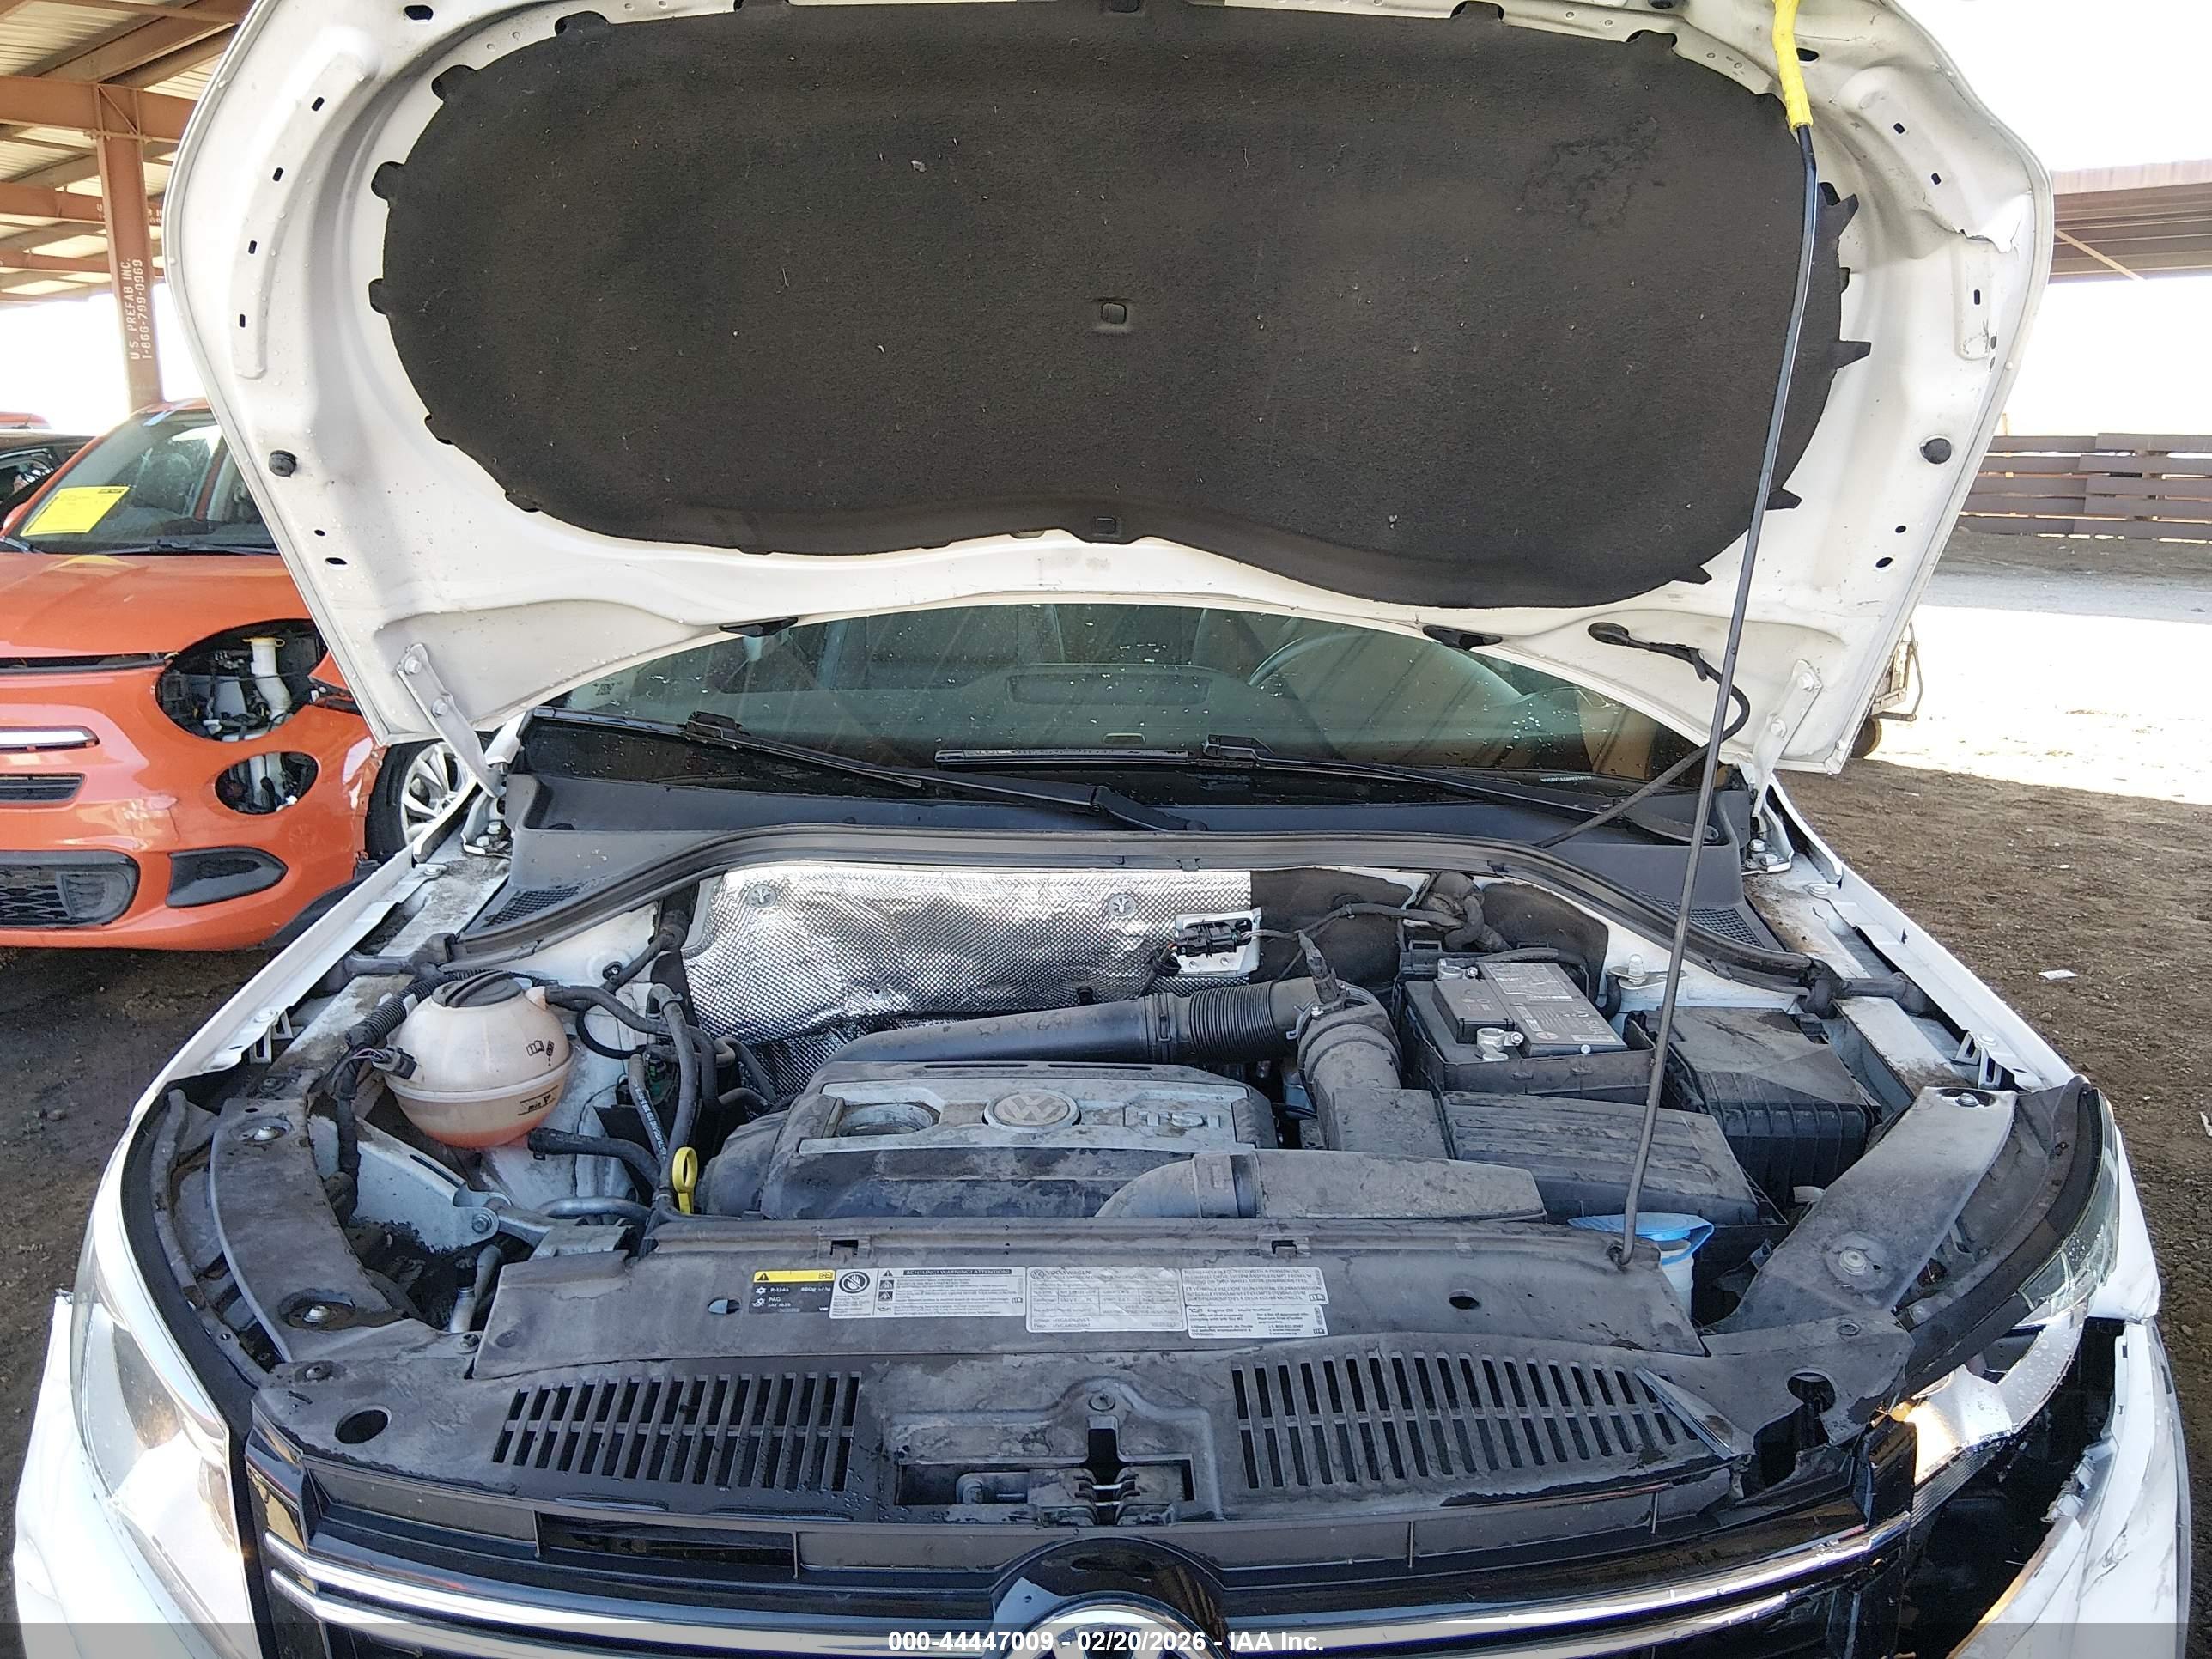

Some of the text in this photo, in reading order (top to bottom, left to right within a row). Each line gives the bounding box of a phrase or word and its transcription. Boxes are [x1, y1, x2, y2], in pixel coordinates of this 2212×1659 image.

[120, 258, 132, 280] INC.
[123, 286, 137, 331] PREFAB
[132, 259, 152, 359] 1-866-799-0969
